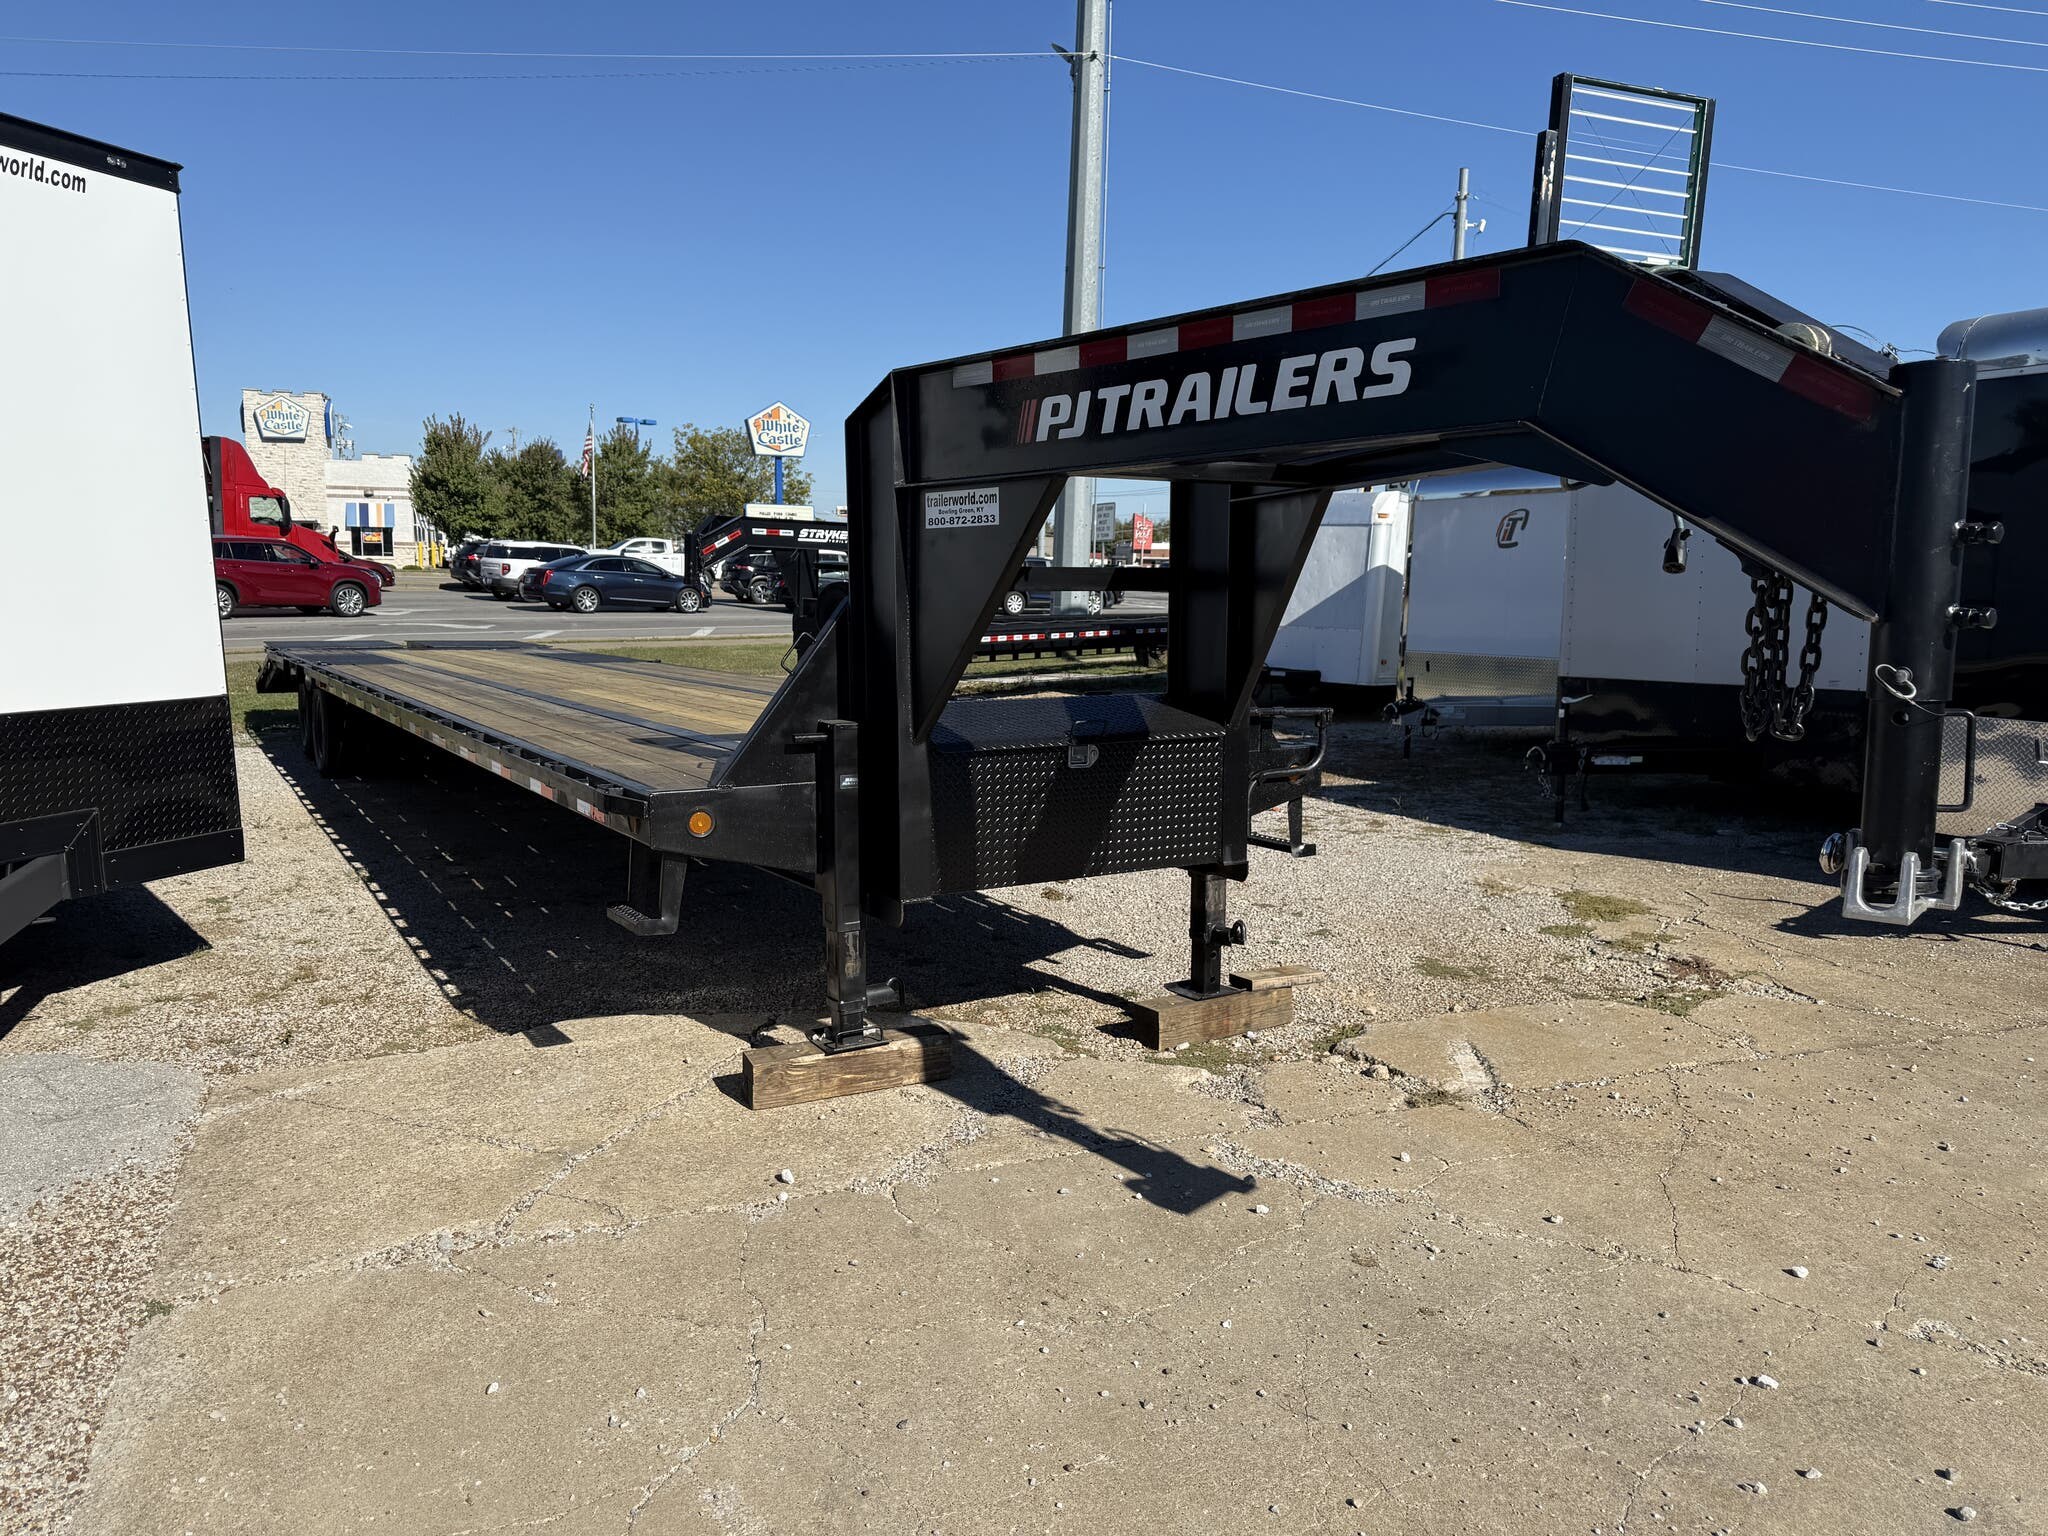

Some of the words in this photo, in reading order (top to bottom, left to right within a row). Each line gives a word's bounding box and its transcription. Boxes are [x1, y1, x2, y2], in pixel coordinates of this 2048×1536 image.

[1036, 391, 1091, 442] PJ
[1098, 337, 1417, 434] TRAILERS
[266, 410, 299, 421] White
[264, 420, 302, 430] Castle
[761, 419, 799, 434] White
[758, 432, 801, 445] Castle
[927, 492, 997, 507] trailerworld.com
[928, 514, 996, 526] 800-872-2833
